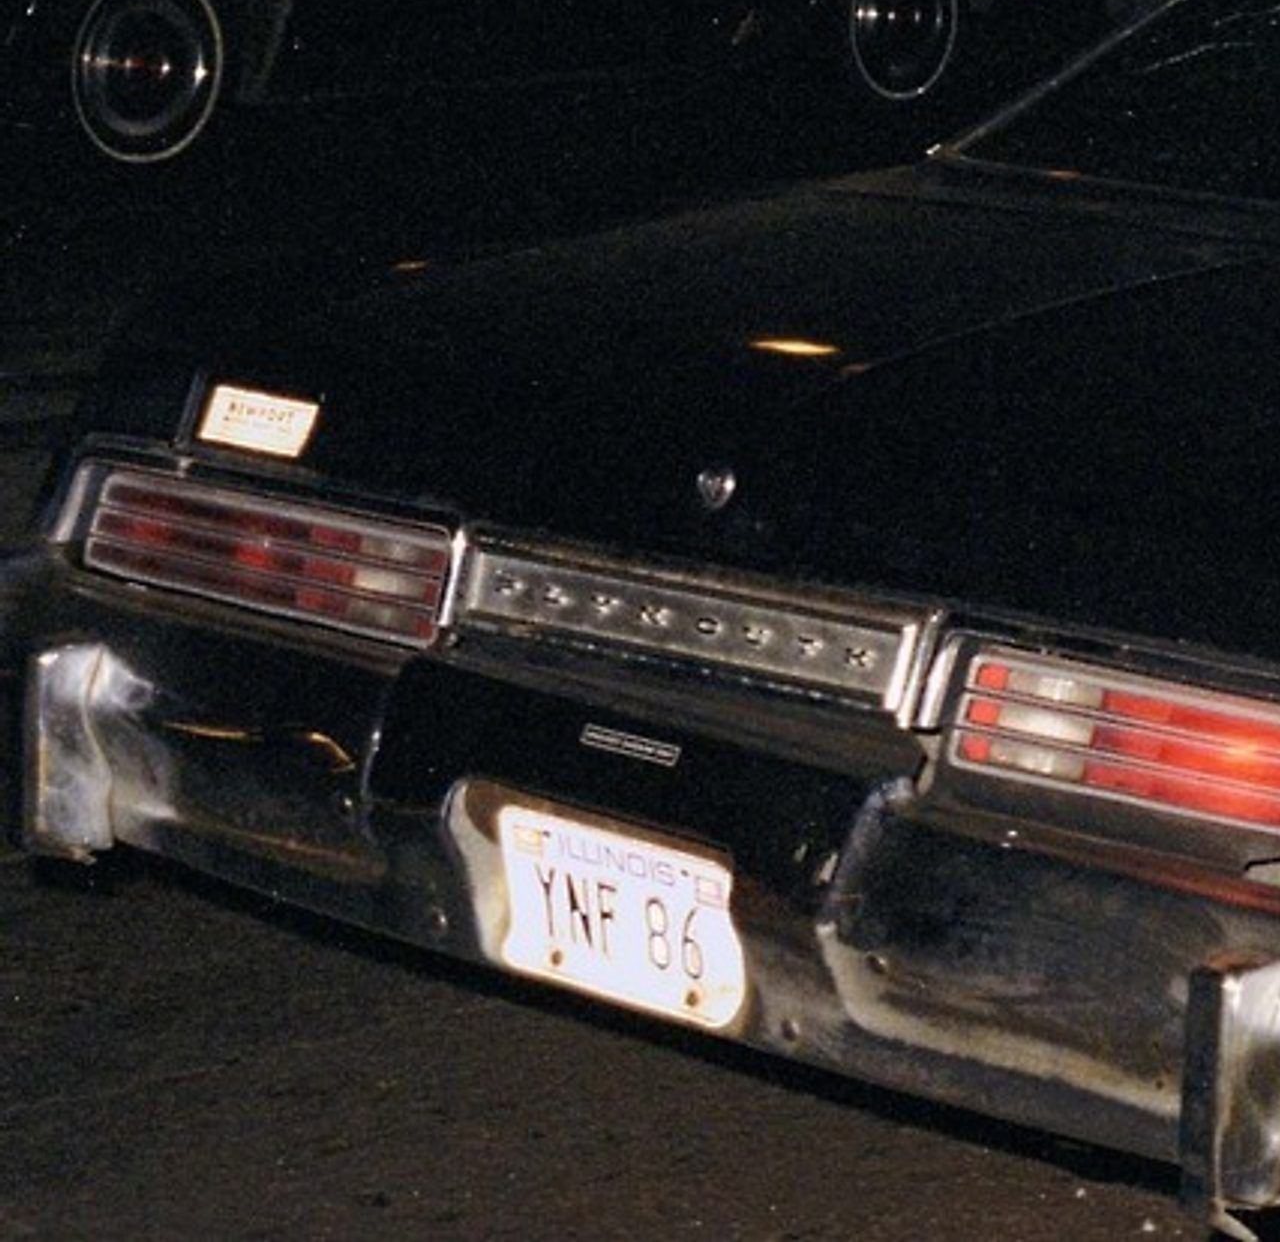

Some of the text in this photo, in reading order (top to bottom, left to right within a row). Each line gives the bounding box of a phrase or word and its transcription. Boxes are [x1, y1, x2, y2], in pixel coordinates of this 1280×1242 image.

[494, 568, 878, 670] PLYMOUTH
[559, 832, 676, 887] ILLINOIS
[533, 863, 703, 980] YNF 86
